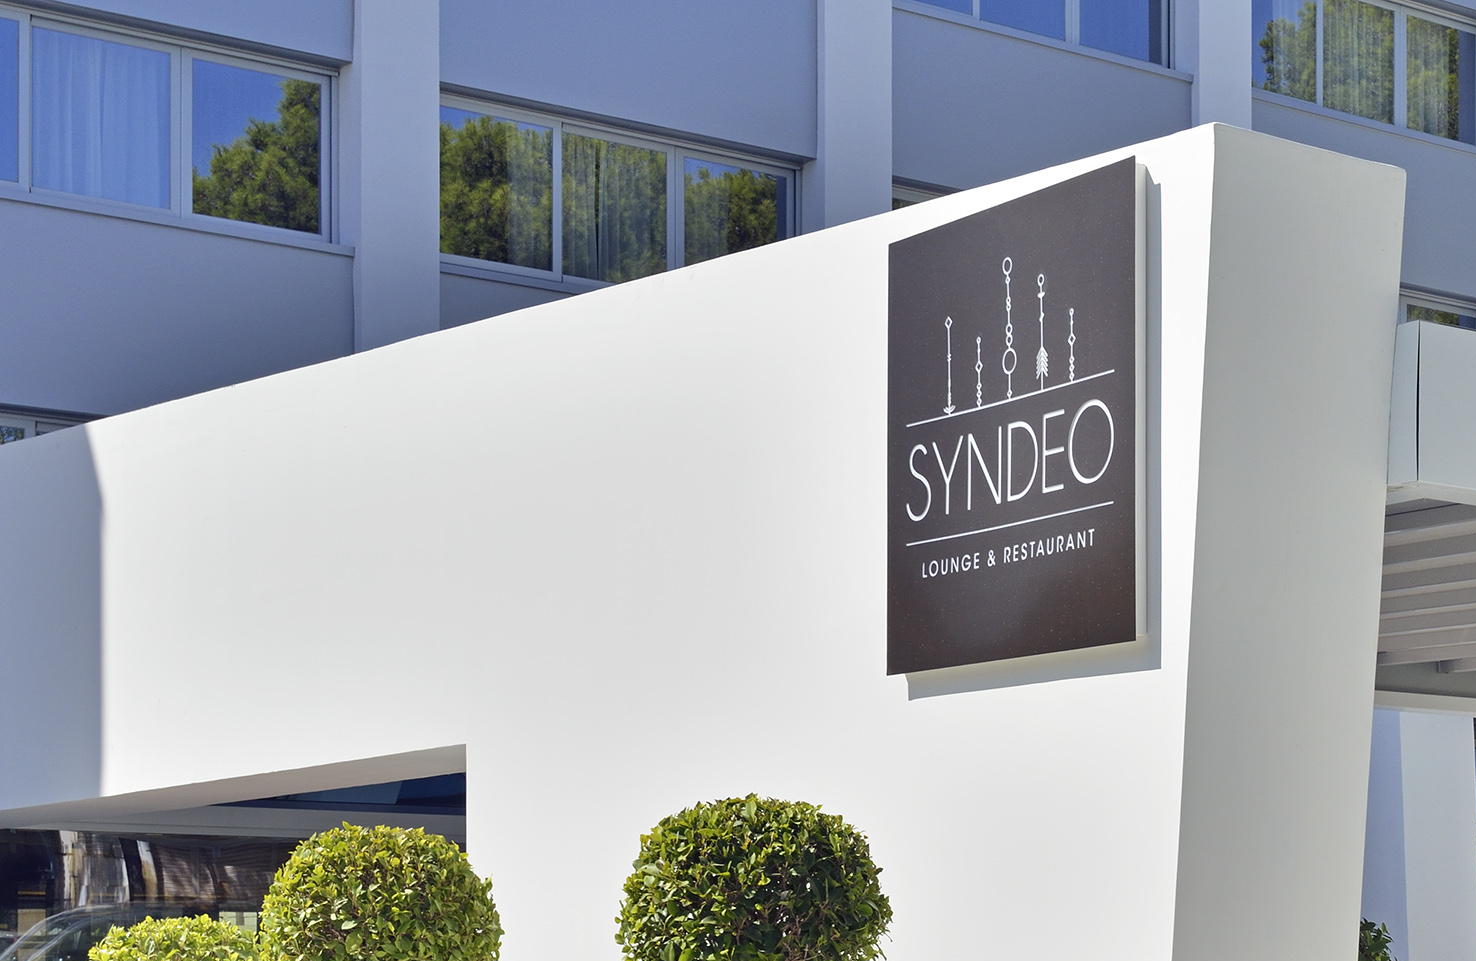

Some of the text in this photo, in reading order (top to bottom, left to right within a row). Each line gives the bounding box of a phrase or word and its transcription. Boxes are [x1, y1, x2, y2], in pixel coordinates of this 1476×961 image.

[906, 399, 1115, 522] SYNDEO
[922, 528, 1096, 579] LOUNGE & RESTAURANT
